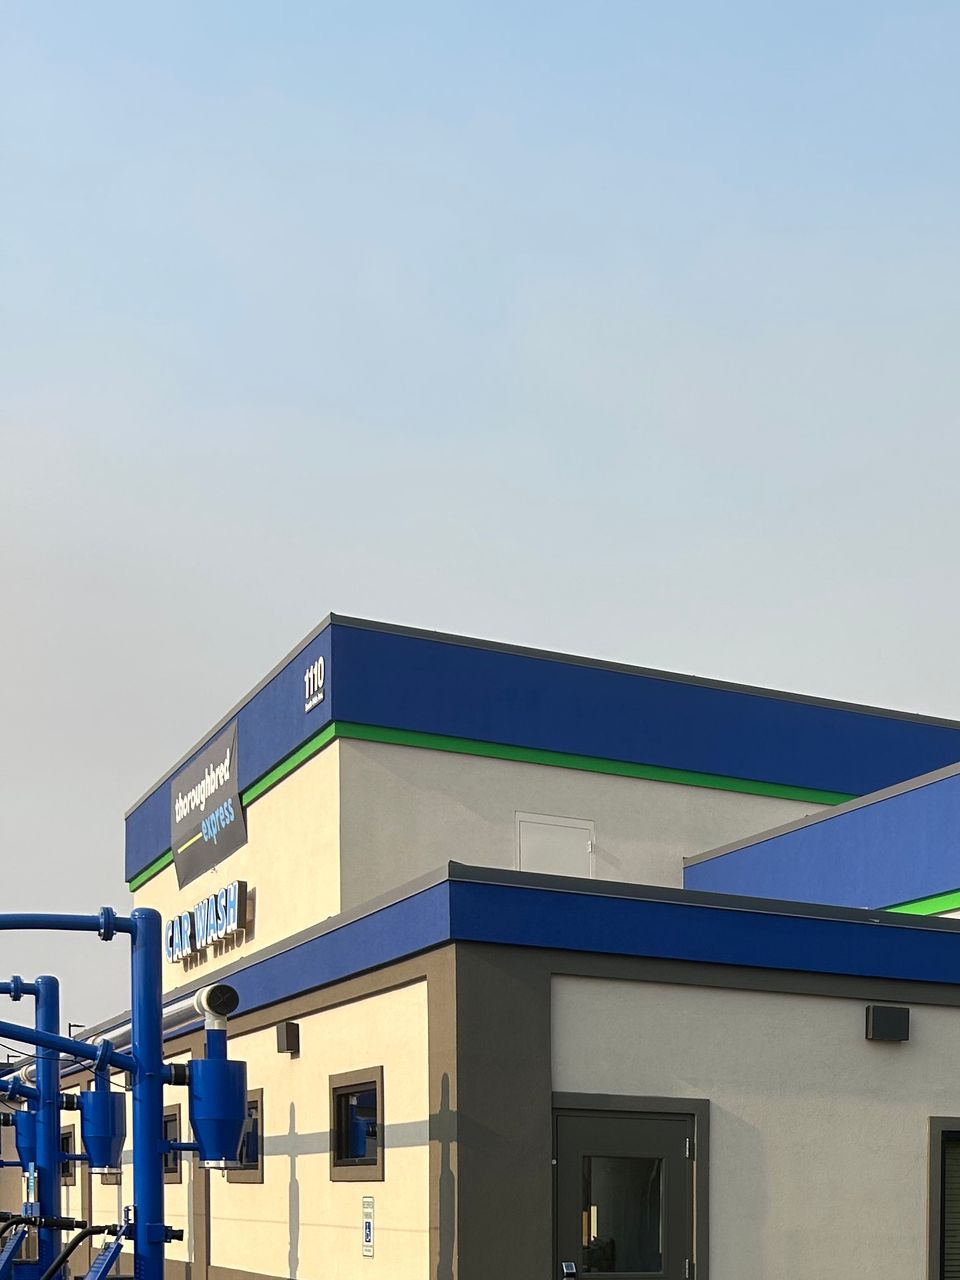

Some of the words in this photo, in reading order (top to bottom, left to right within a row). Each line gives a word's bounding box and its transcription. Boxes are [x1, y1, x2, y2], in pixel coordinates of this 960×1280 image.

[304, 655, 325, 699] 1110
[175, 747, 230, 824] thoroughbred
[201, 797, 235, 845] express
[165, 911, 192, 964] CAR
[194, 880, 240, 950] WASH
